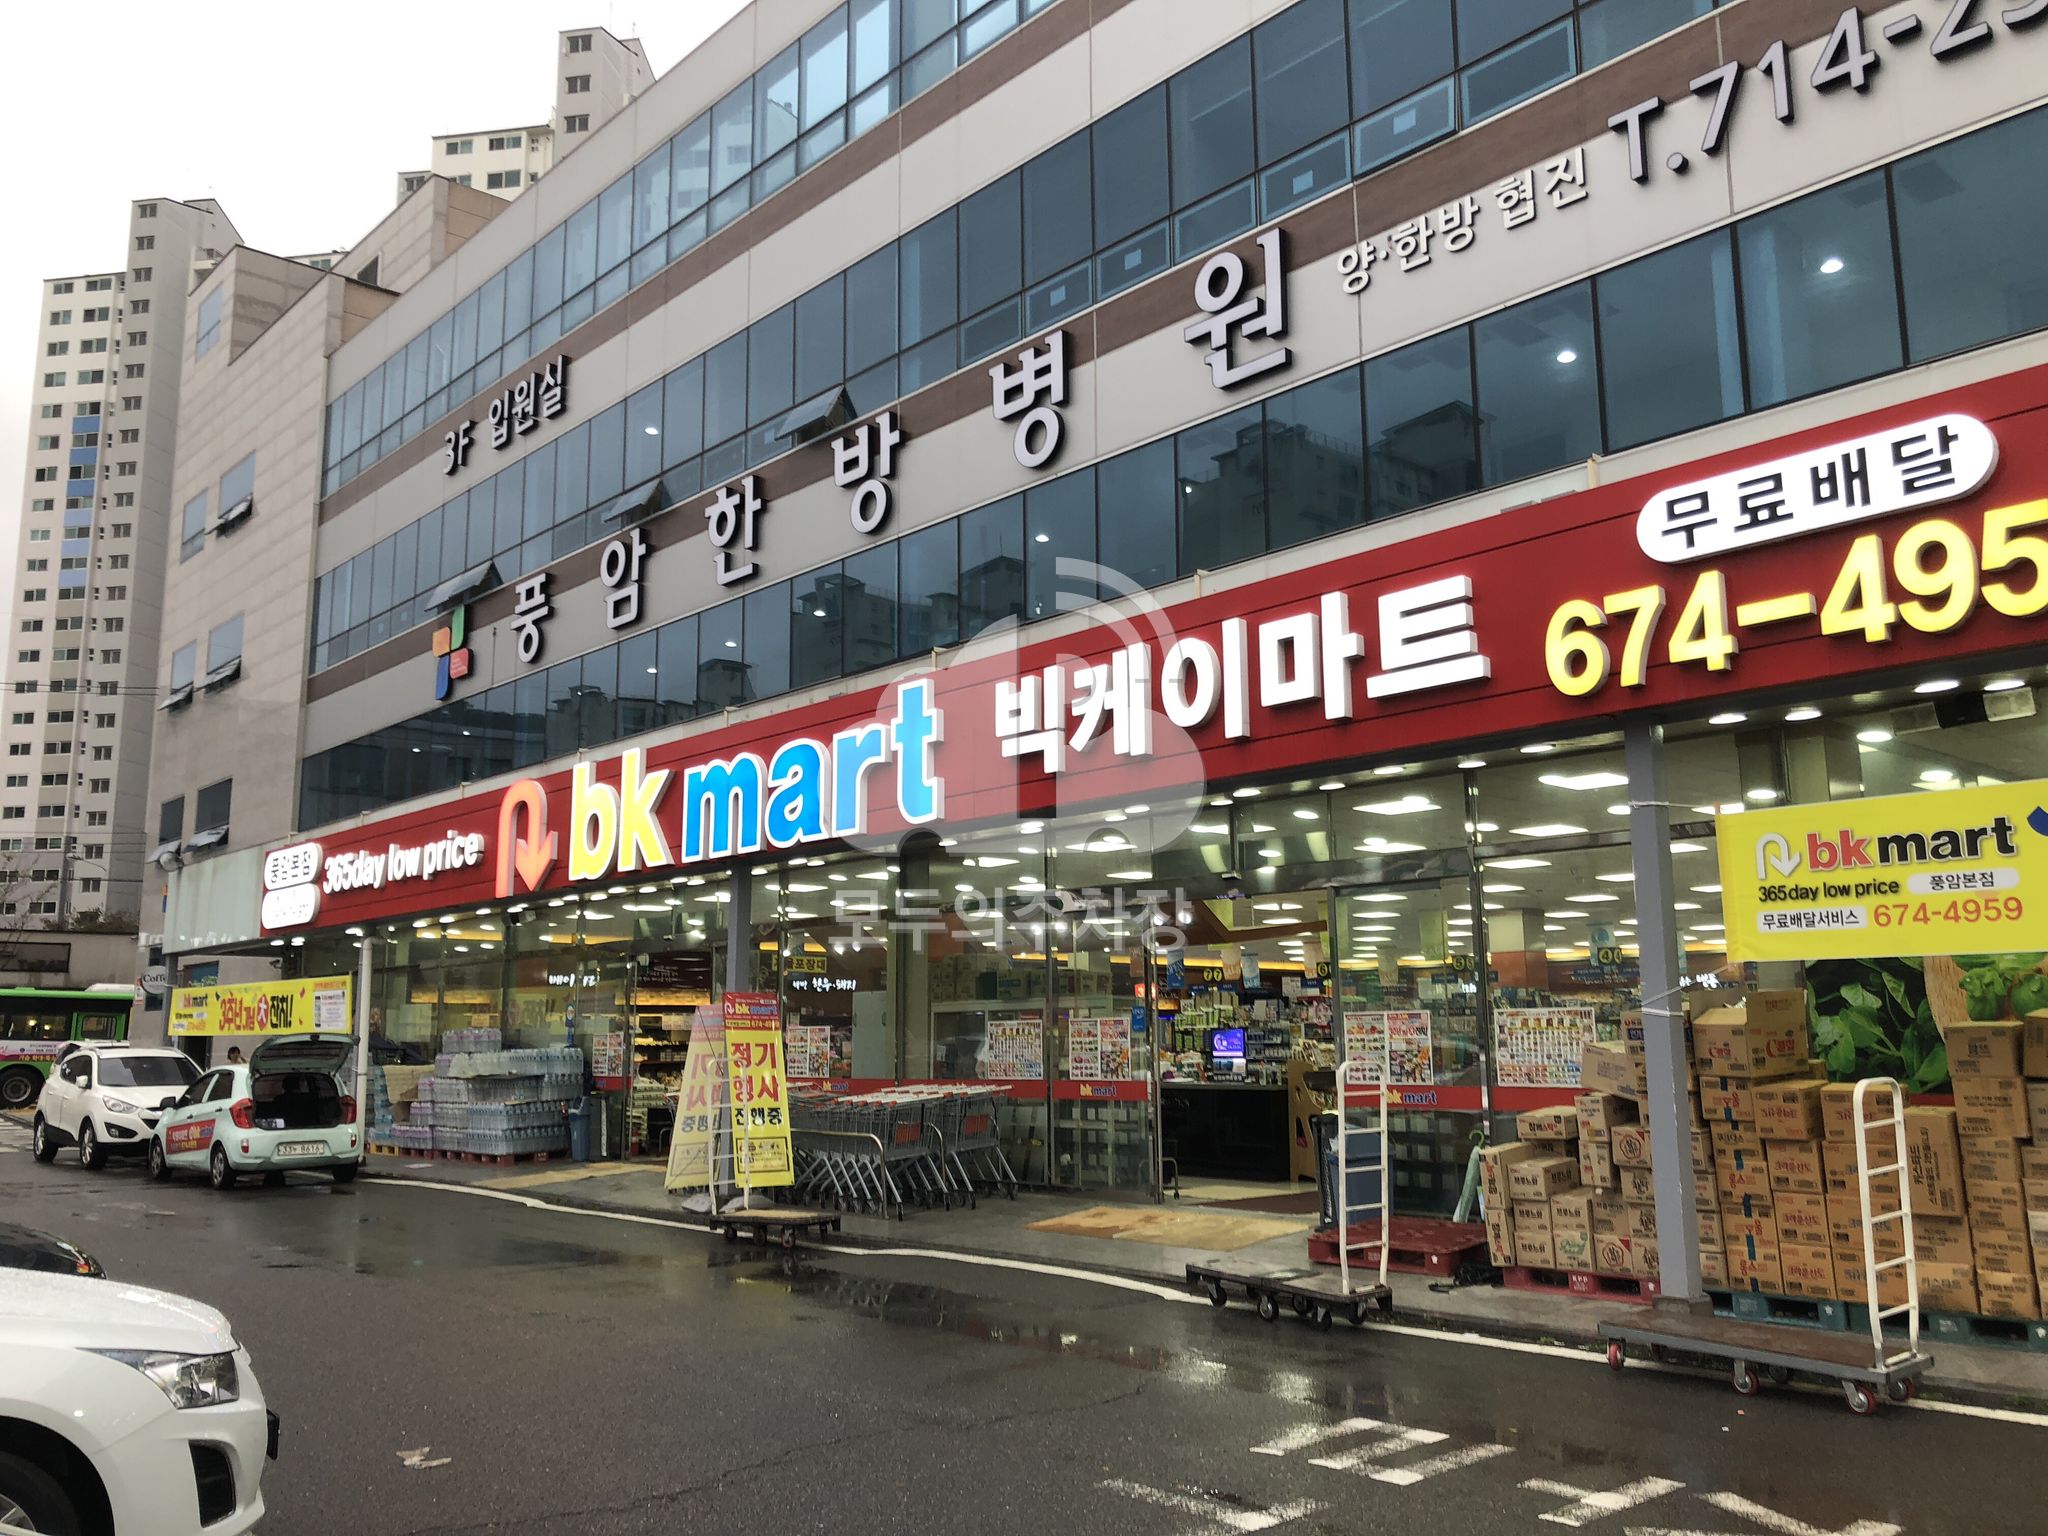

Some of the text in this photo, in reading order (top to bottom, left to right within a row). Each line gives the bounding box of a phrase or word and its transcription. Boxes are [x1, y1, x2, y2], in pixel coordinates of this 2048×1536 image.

[1496, 147, 1589, 229] 협진
[443, 353, 570, 475] 3F 입원실
[1661, 424, 1959, 549] 무료배달
[995, 574, 1492, 774] 빅케이마트
[568, 678, 945, 882] bk mart
[323, 829, 485, 895] 365day low price
[1929, 871, 1996, 892] 풍암본점
[1758, 878, 1901, 903] 365day low price
[1873, 896, 2024, 929] 674-4959
[1762, 910, 1861, 932] 무료배달서비스
[731, 1042, 777, 1069] 정기
[733, 1075, 779, 1102] 행사
